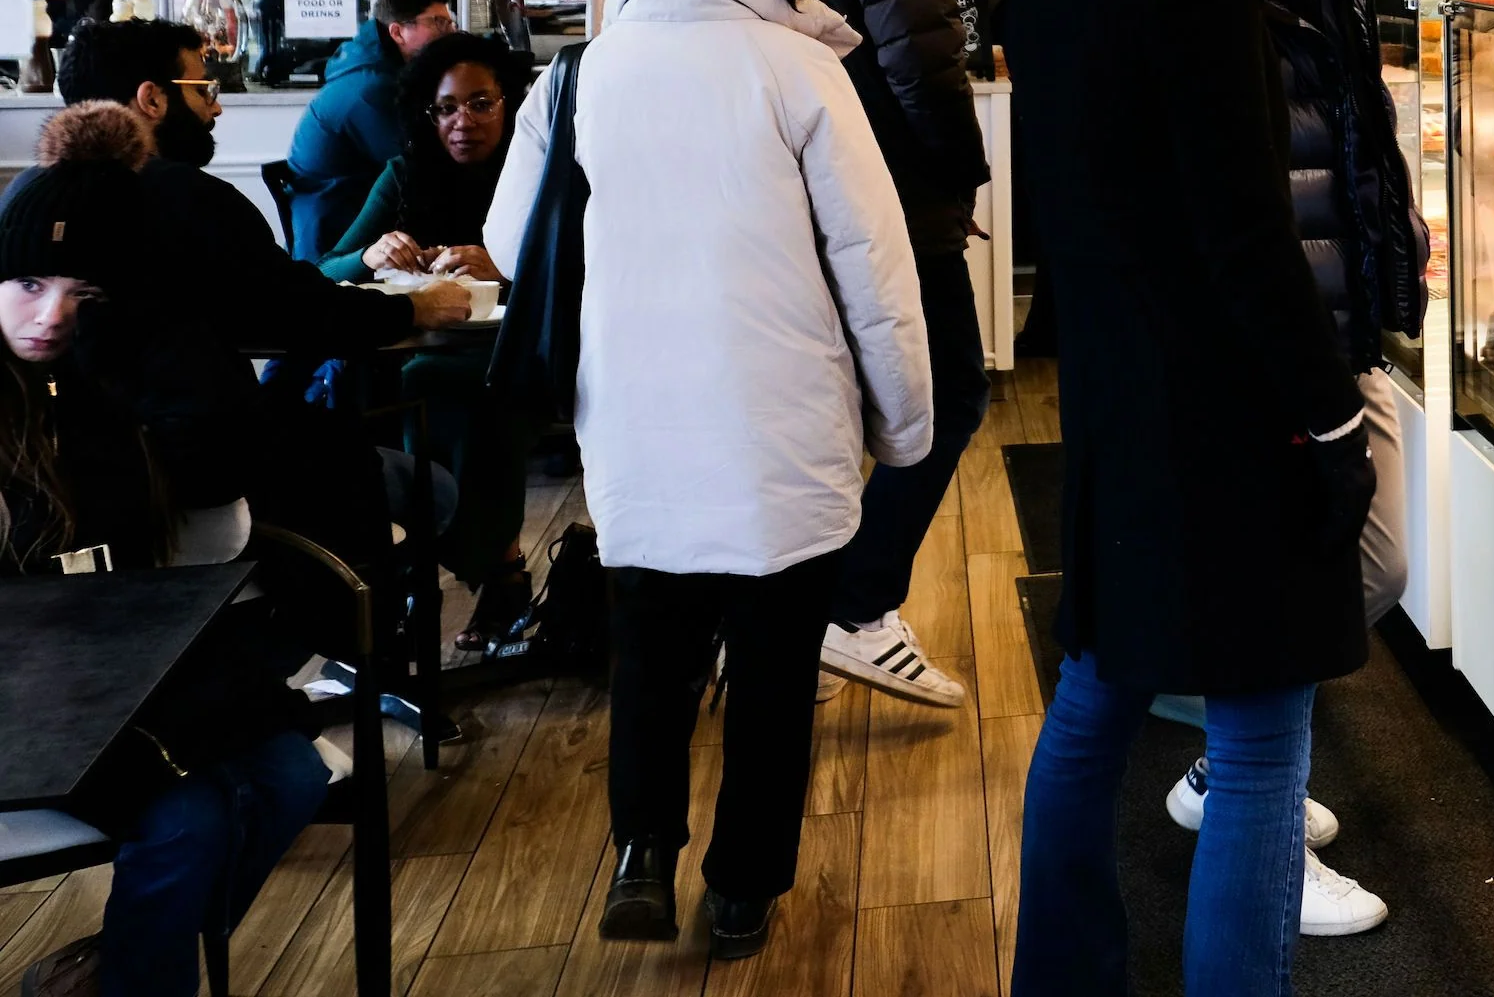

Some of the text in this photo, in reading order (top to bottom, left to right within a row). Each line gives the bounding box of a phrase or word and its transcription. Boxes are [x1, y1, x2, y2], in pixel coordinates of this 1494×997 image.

[297, 0, 344, 8] FOOD OR
[301, 10, 341, 19] DRINKS
